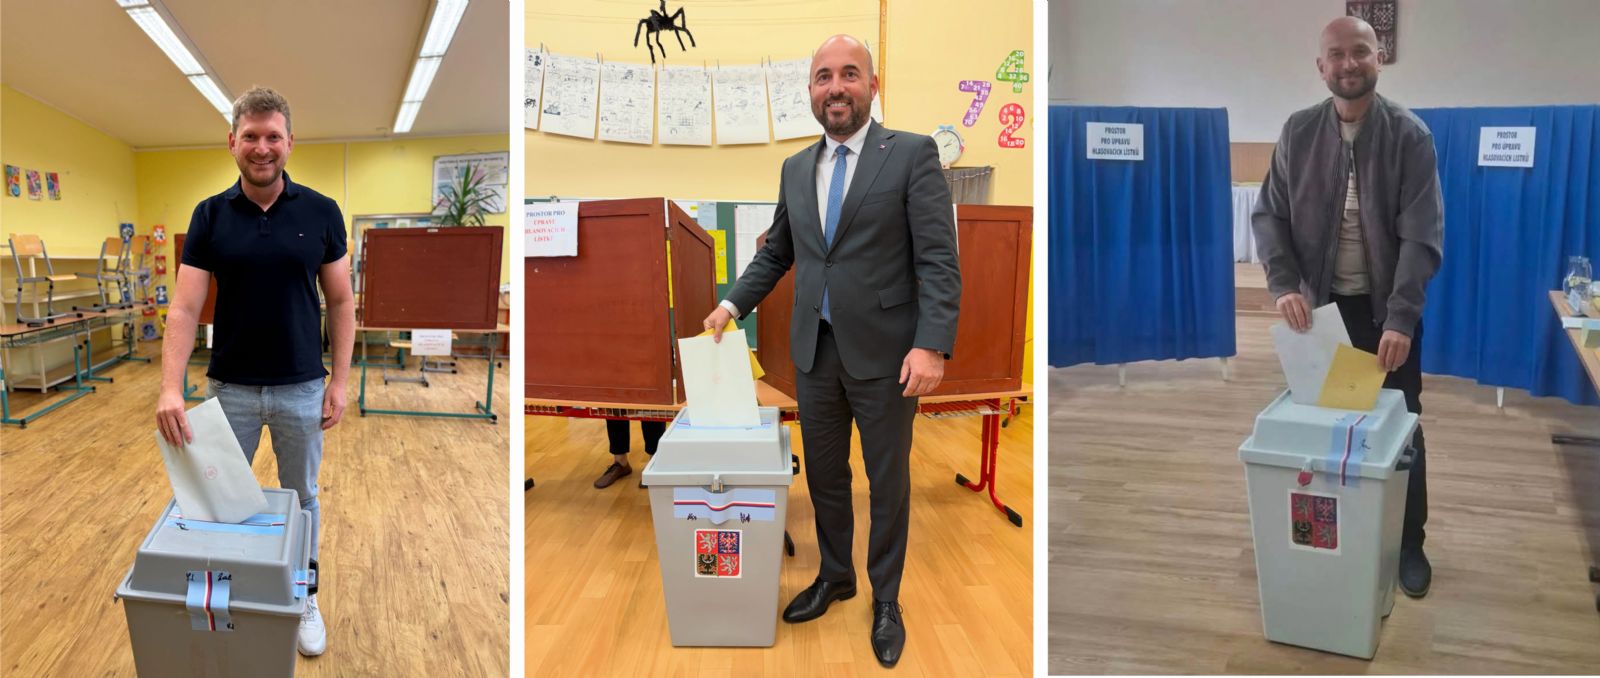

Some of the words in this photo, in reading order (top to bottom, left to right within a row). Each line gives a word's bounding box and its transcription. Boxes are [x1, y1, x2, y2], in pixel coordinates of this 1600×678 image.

[996, 50, 1029, 93] 4
[959, 80, 991, 127] 7
[998, 103, 1025, 148] 2
[1491, 142, 1501, 150] PRO
[1496, 131, 1518, 139] PROSTOR
